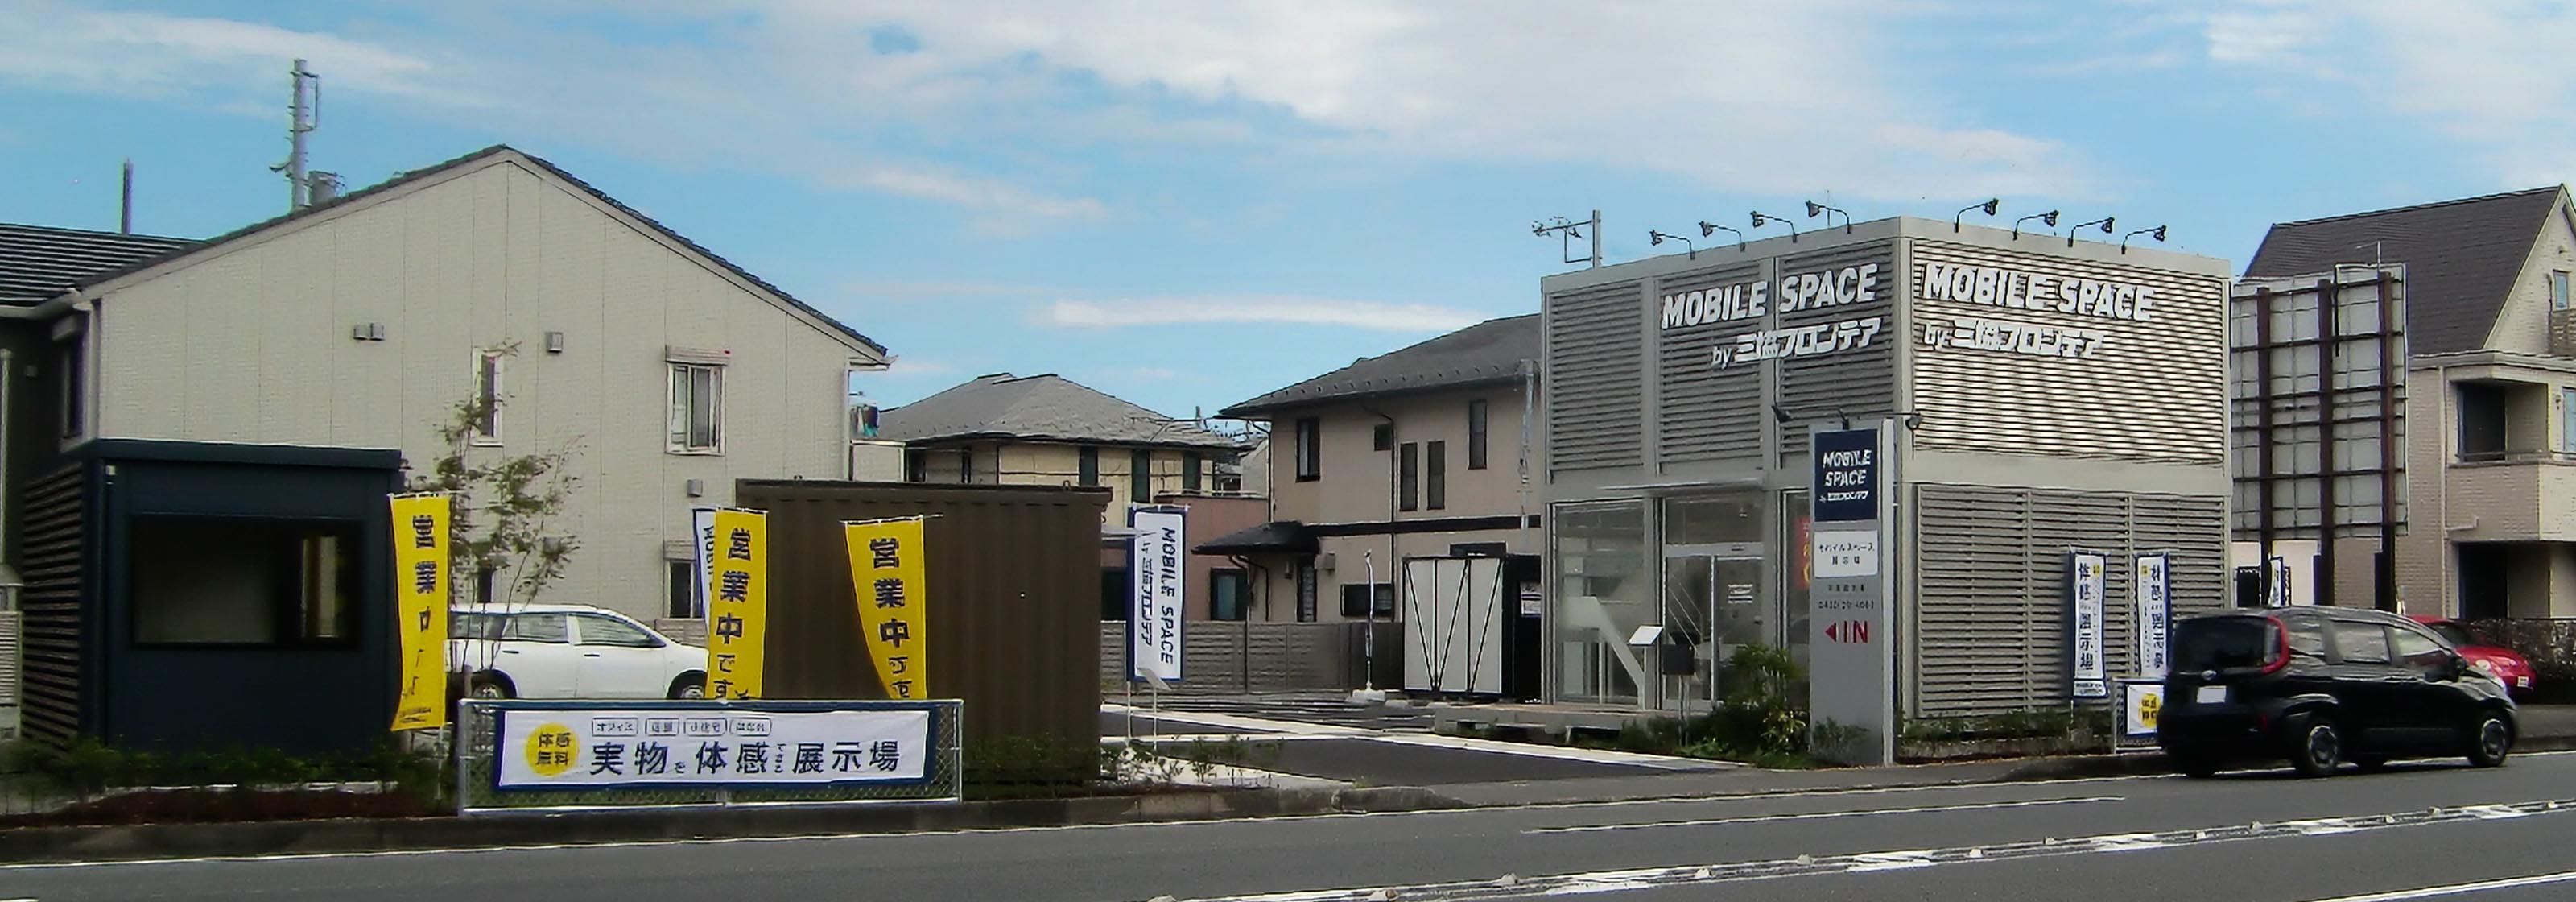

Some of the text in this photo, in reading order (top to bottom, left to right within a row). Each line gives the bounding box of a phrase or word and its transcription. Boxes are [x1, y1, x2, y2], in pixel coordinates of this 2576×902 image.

[1661, 263, 1878, 330] MOBILE SPACE
[1923, 262, 2156, 321] MOBILE SPACE
[1711, 345, 1731, 370] by
[1823, 449, 1872, 469] MOBILE
[1824, 469, 1867, 486] SPACE
[1160, 526, 1175, 664] MOBILE SPACE
[1843, 619, 1868, 643] IN
